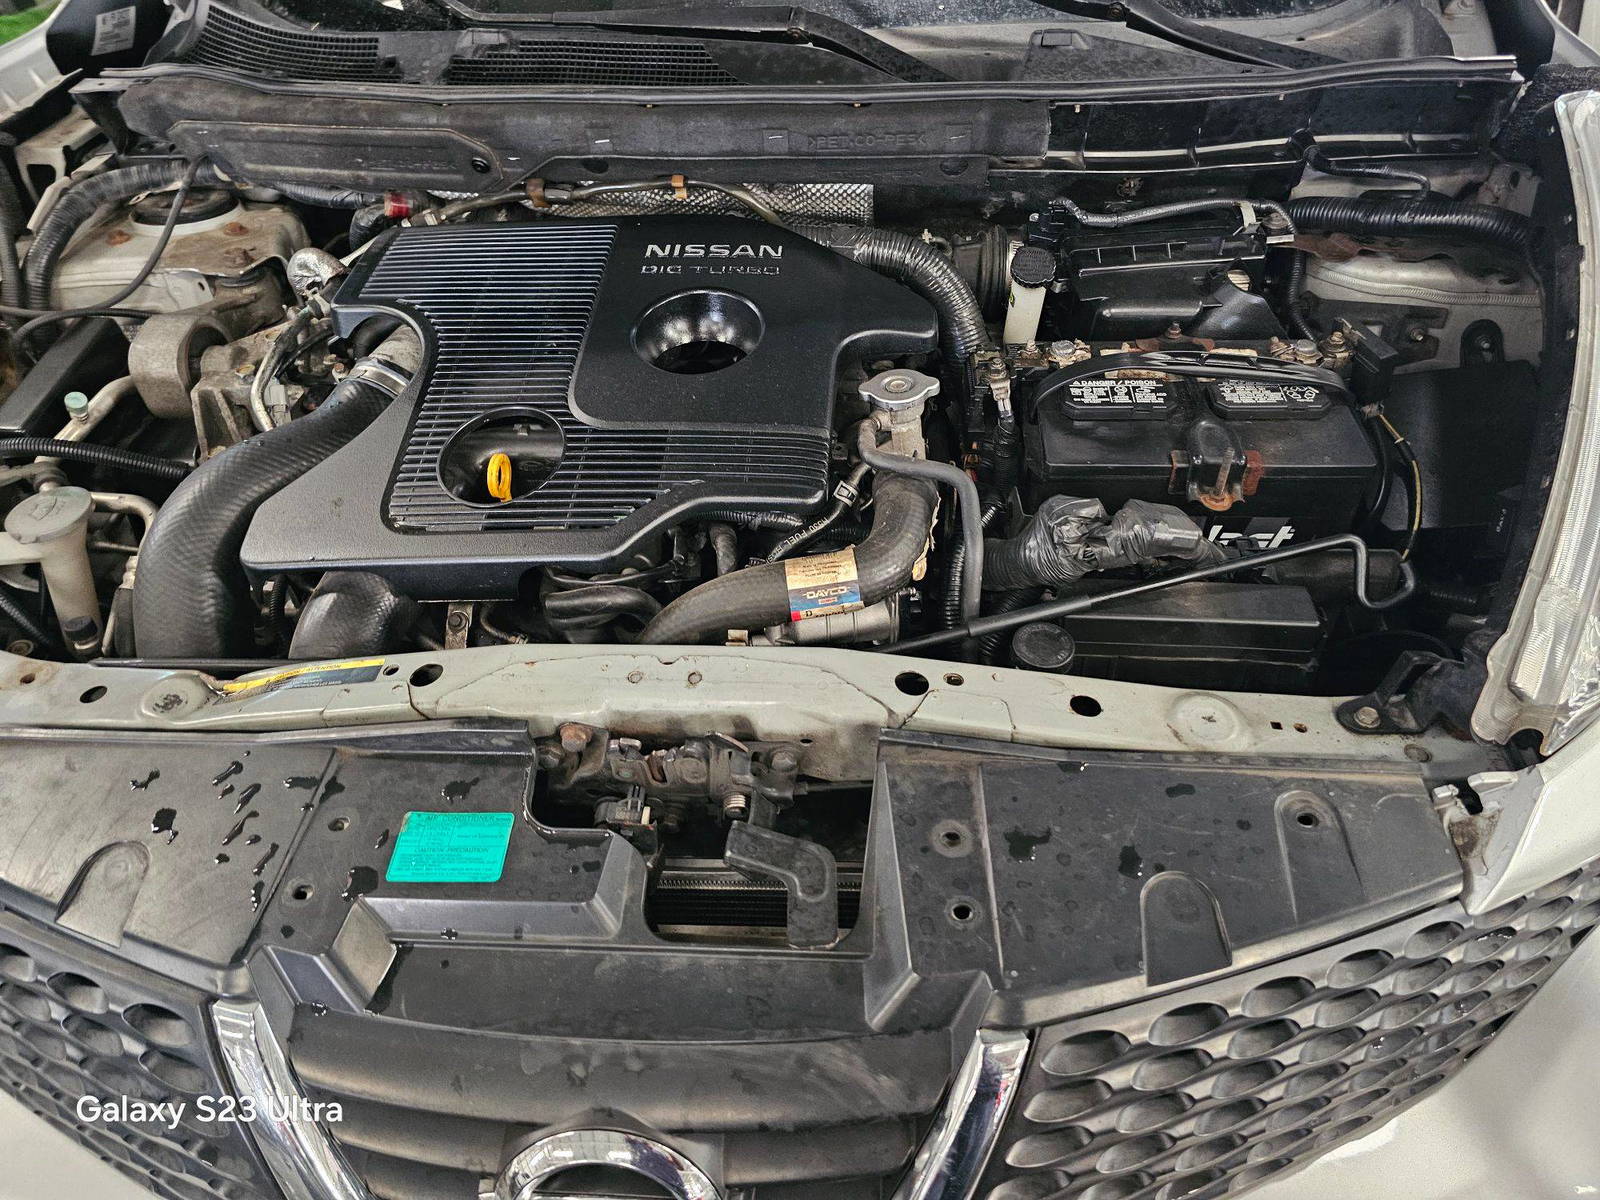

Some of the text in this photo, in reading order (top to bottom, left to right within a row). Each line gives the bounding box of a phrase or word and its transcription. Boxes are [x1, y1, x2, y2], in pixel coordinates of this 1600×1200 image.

[644, 243, 783, 259] NISSAN
[640, 264, 780, 275] DIG TURBO
[783, 529, 808, 546] FUEL
[805, 585, 848, 599] DAYCO
